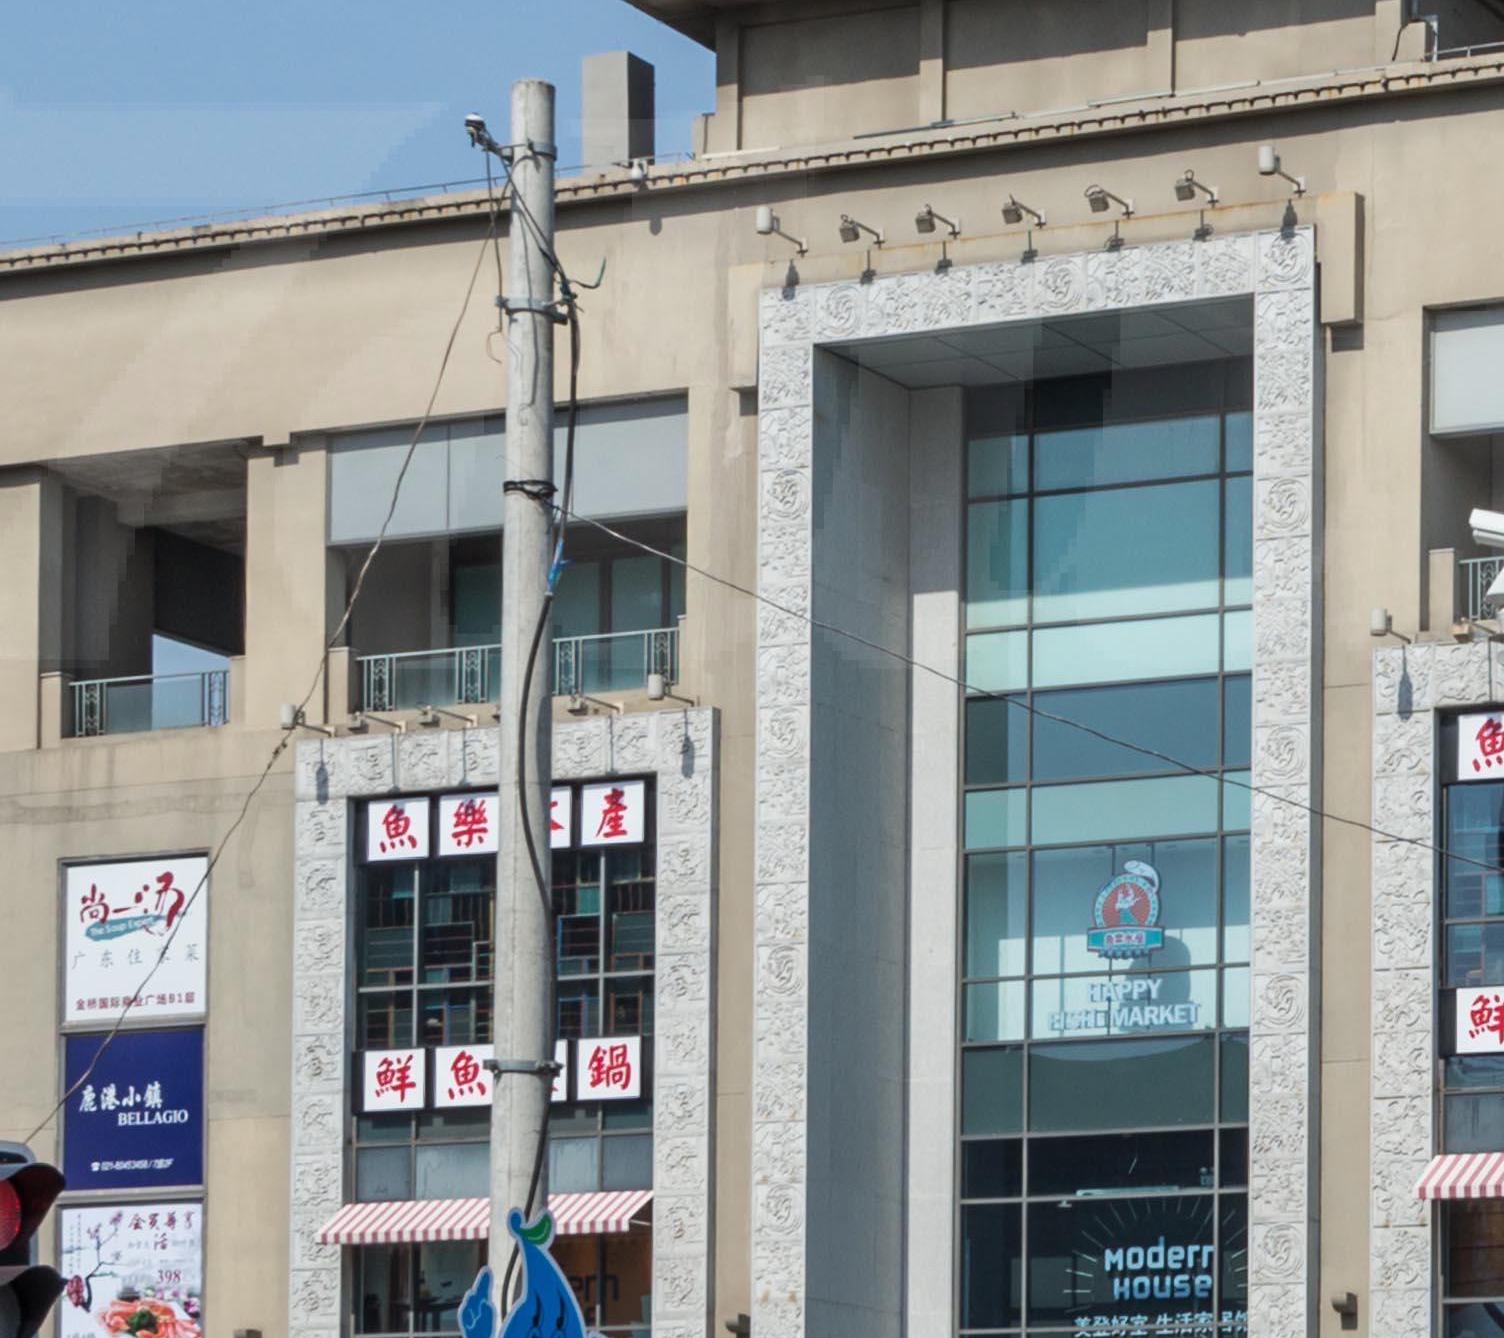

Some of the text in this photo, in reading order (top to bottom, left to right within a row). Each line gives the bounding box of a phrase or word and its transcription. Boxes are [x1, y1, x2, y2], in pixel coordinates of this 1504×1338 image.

[380, 778, 629, 855] 魚樂產
[1088, 979, 1162, 1003] HAPPY
[1110, 1003, 1200, 1027] MARKET
[375, 1044, 632, 1102] 鮮魚鍋
[117, 1109, 189, 1127] BELLAGIO
